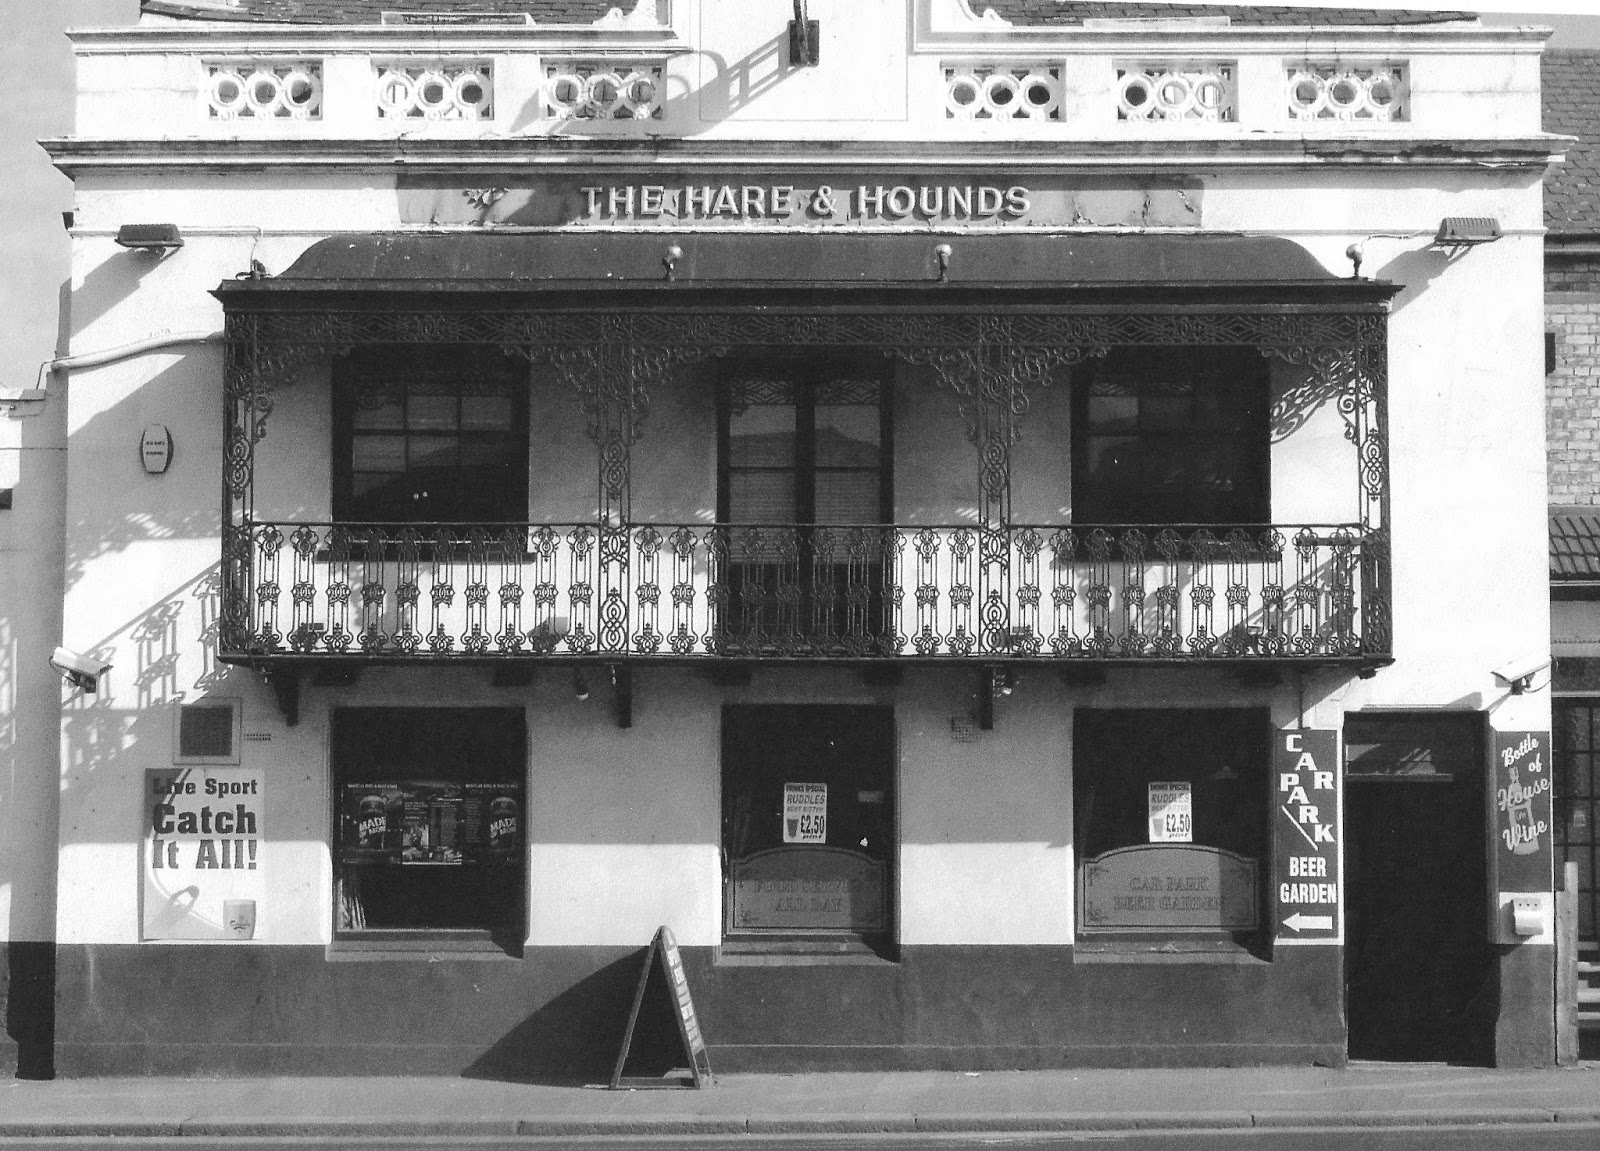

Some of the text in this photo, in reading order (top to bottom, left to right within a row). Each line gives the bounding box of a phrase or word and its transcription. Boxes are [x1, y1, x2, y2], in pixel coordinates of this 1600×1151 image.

[580, 185, 1032, 217] THE HARE & HOUNDS
[1285, 733, 1335, 790] CAR
[1501, 733, 1540, 767] Bottle
[1528, 753, 1543, 773] of
[152, 777, 258, 799] Live Sport
[786, 794, 826, 805] RUDDLES
[1497, 777, 1550, 812] House
[152, 803, 258, 835] Catch
[1165, 813, 1191, 833] £2.50
[1280, 772, 1335, 843] PARK
[358, 816, 387, 832] MADE
[1502, 820, 1548, 851] Wine
[152, 838, 258, 871] It All!
[1289, 856, 1328, 878] BEER
[1280, 882, 1338, 904] GARDEN
